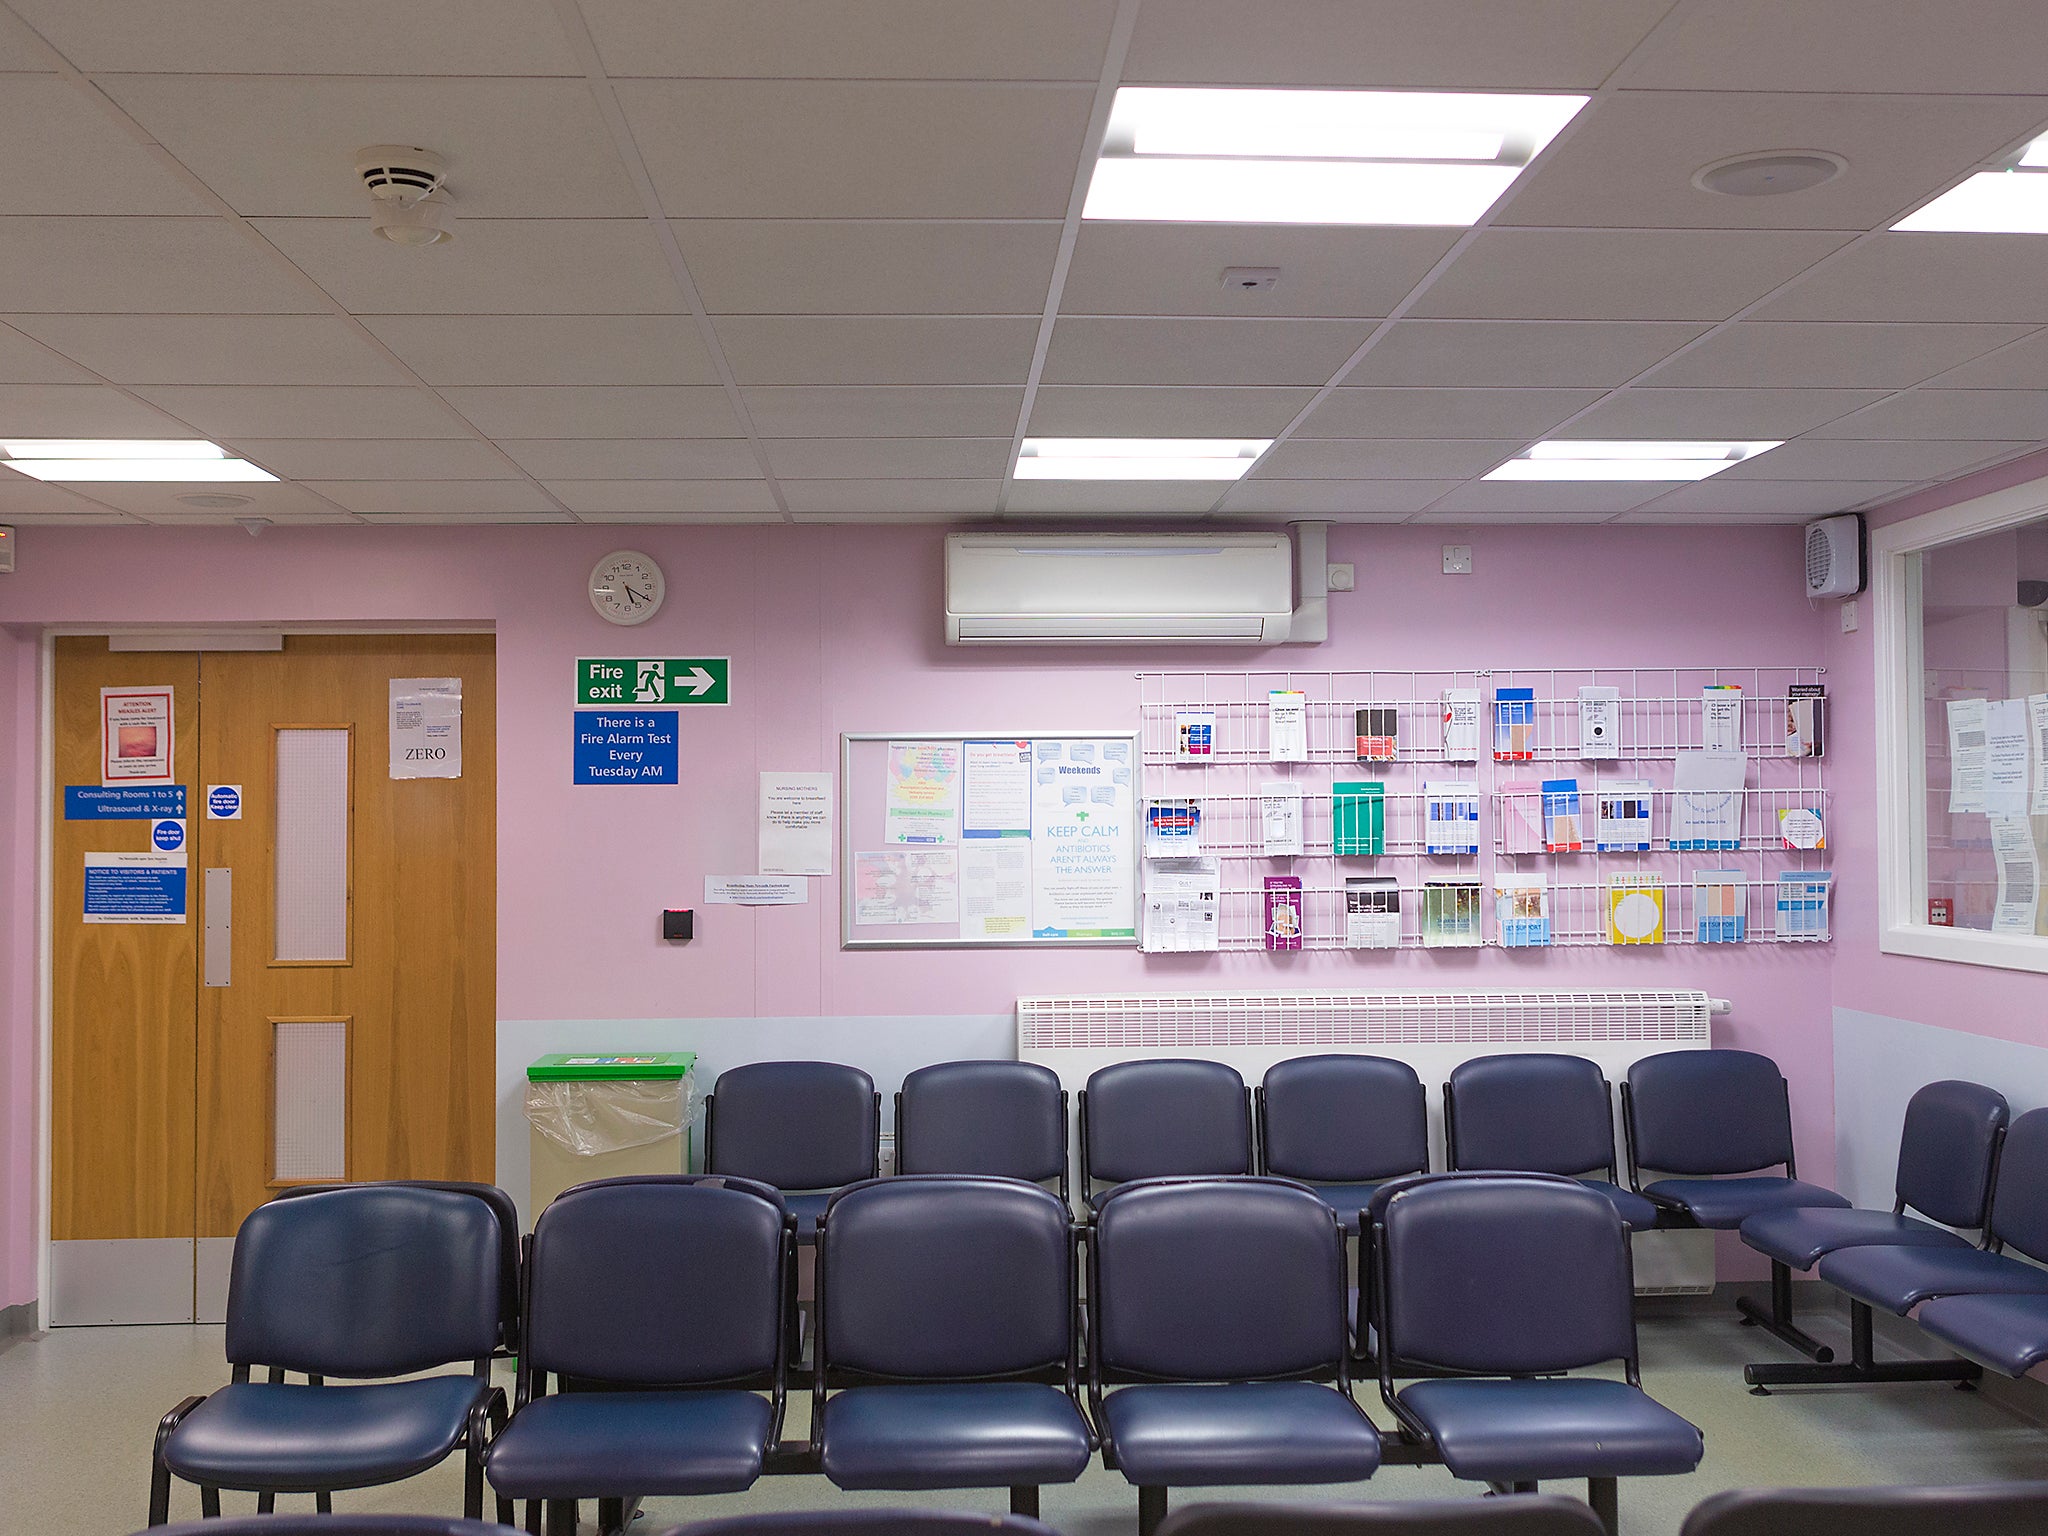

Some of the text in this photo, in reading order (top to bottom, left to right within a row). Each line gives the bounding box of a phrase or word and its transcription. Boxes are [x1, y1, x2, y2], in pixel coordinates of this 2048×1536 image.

[590, 664, 624, 679] Fire
[589, 684, 622, 698] exit
[596, 717, 655, 727] There is a
[581, 734, 671, 744] Fire Alarm Test
[405, 748, 446, 760] ZERO
[609, 750, 643, 762] Every
[589, 766, 663, 779] Tuesday AM
[1059, 766, 1101, 774] Weekends
[78, 791, 120, 799] Consulting
[1048, 826, 1118, 837] KEEP CALM
